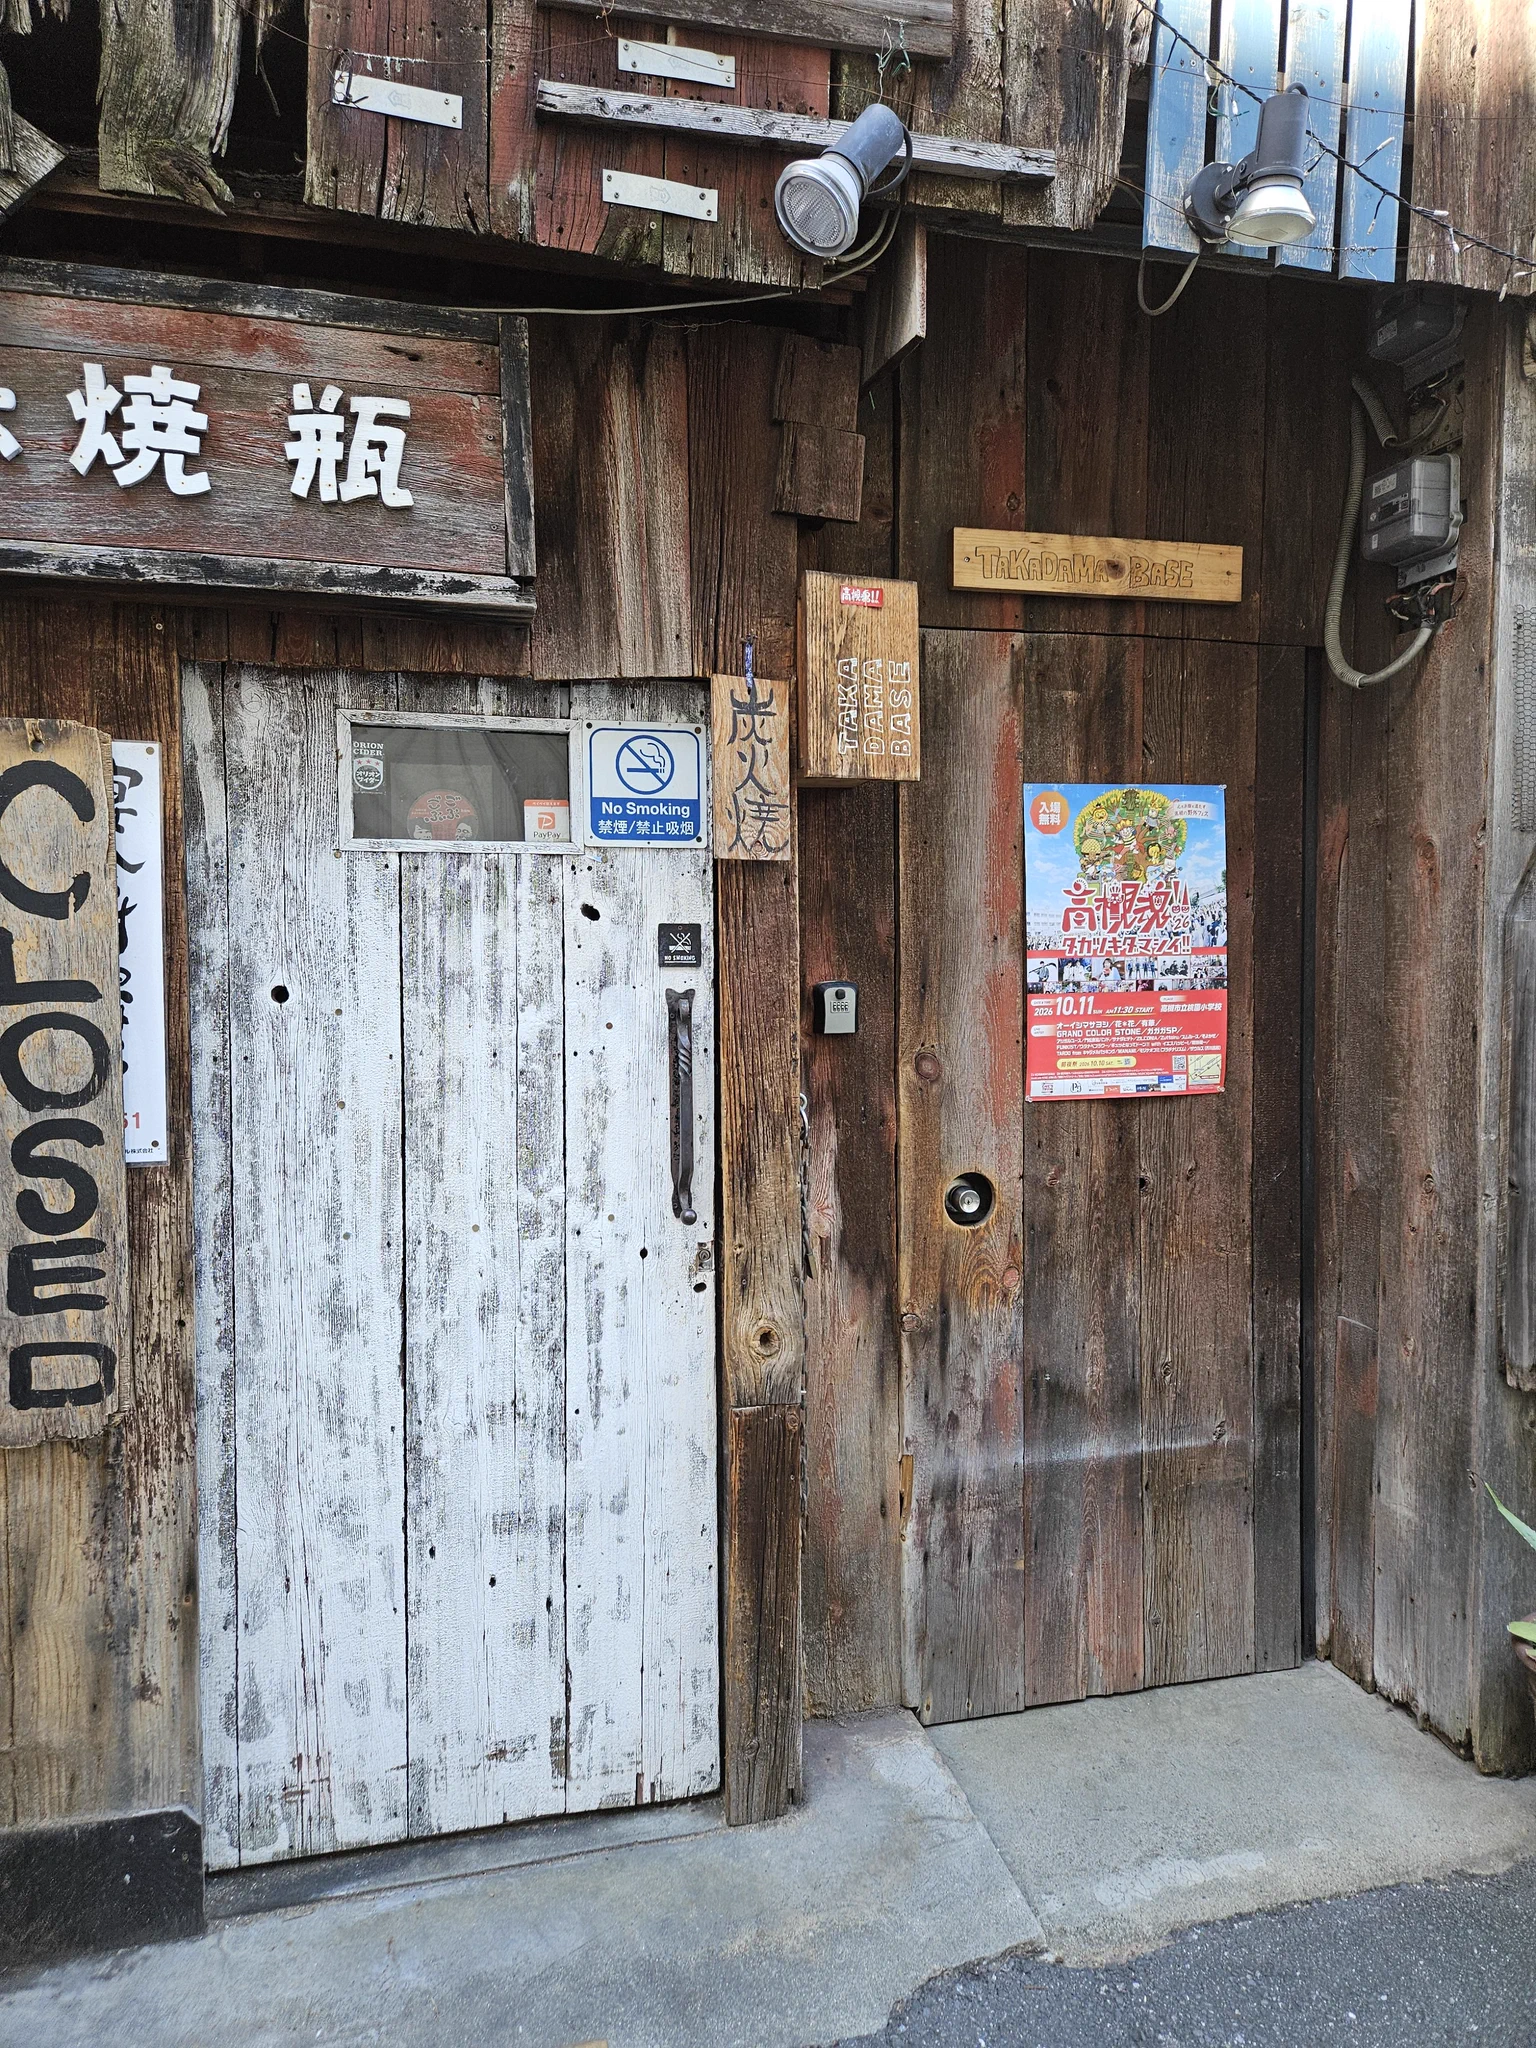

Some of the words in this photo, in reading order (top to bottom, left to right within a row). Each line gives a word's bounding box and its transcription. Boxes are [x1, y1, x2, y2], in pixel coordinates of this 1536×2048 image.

[1128, 555, 1194, 589] BASE
[837, 657, 859, 755] TAKA
[863, 658, 885, 755] DAMA
[888, 660, 912, 757] BASE
[353, 741, 384, 750] ORION
[725, 680, 789, 853] 炭火焼
[601, 801, 623, 815] No
[626, 802, 690, 819] Smoking
[1039, 801, 1061, 814] 入場
[598, 819, 694, 836] 禁煙/禁止吸烟
[1038, 813, 1061, 826] 無料
[533, 831, 561, 839] PayPay
[1062, 877, 1190, 934] 高槻魂!!
[1034, 1007, 1053, 1016] 2026
[1056, 996, 1094, 1015] 10.11
[1057, 1029, 1083, 1038] GRAND
[1085, 1028, 1112, 1037] COLOR
[0, 760, 117, 1411] CLOSED
